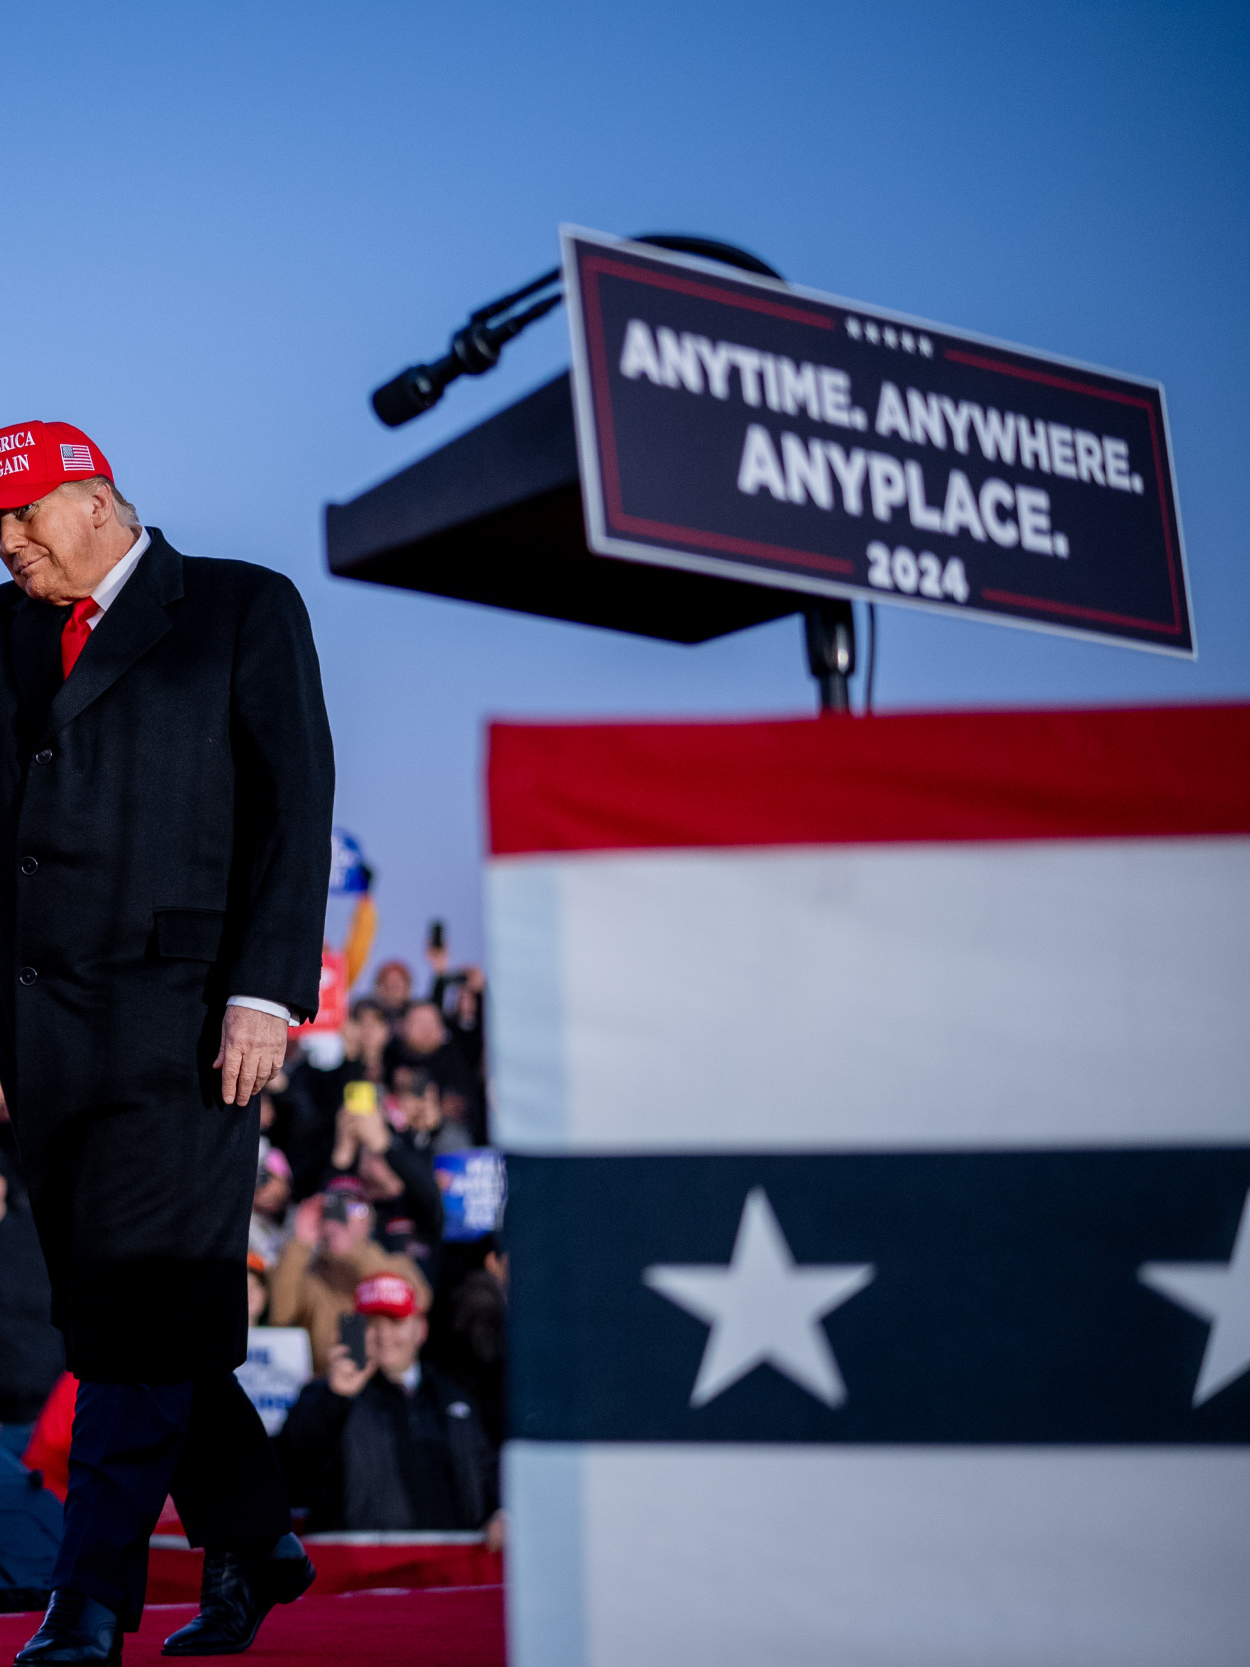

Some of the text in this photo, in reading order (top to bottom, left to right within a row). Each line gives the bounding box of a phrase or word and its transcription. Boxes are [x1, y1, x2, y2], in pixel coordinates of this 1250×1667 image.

[618, 317, 1144, 495] ANYTIME. ANYWHERE.
[737, 422, 1070, 559] ANYPLACE.
[865, 540, 970, 604] 2024
